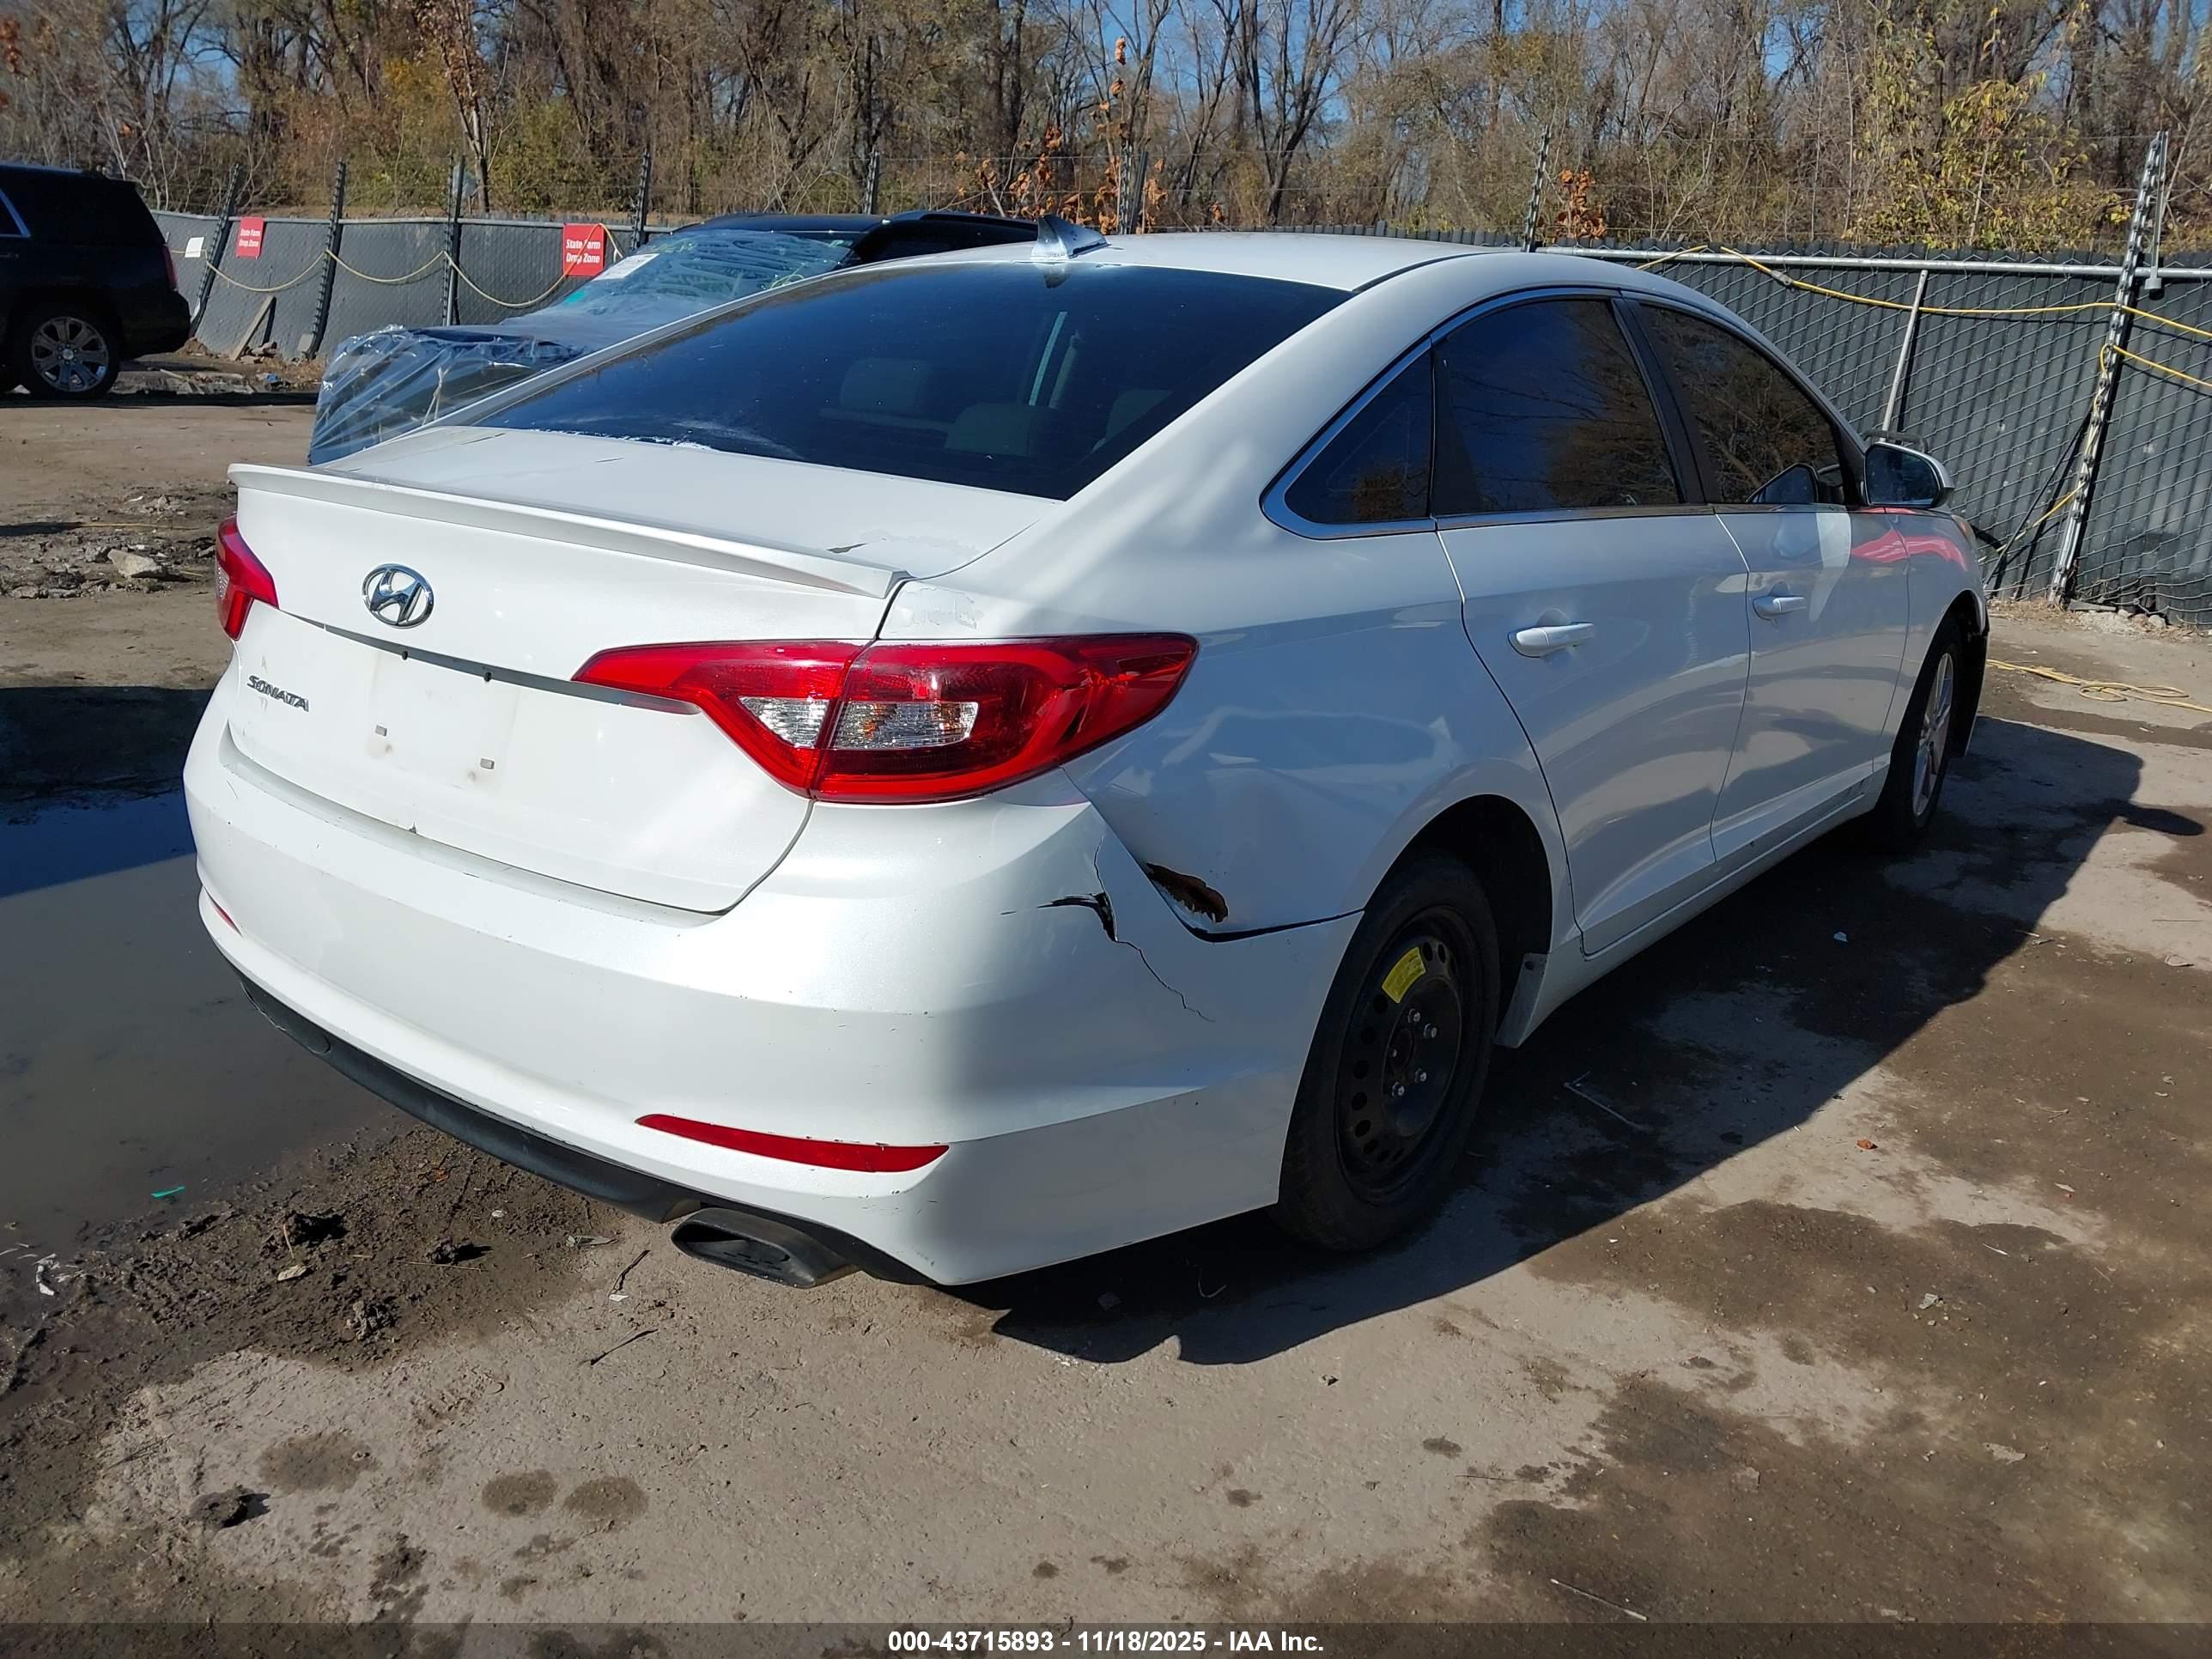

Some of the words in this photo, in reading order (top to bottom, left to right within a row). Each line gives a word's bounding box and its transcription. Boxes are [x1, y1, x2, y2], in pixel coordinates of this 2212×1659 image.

[566, 239, 583, 249] State
[566, 253, 583, 264] Drop
[583, 253, 600, 263] Zone
[246, 674, 309, 712] SONATA
